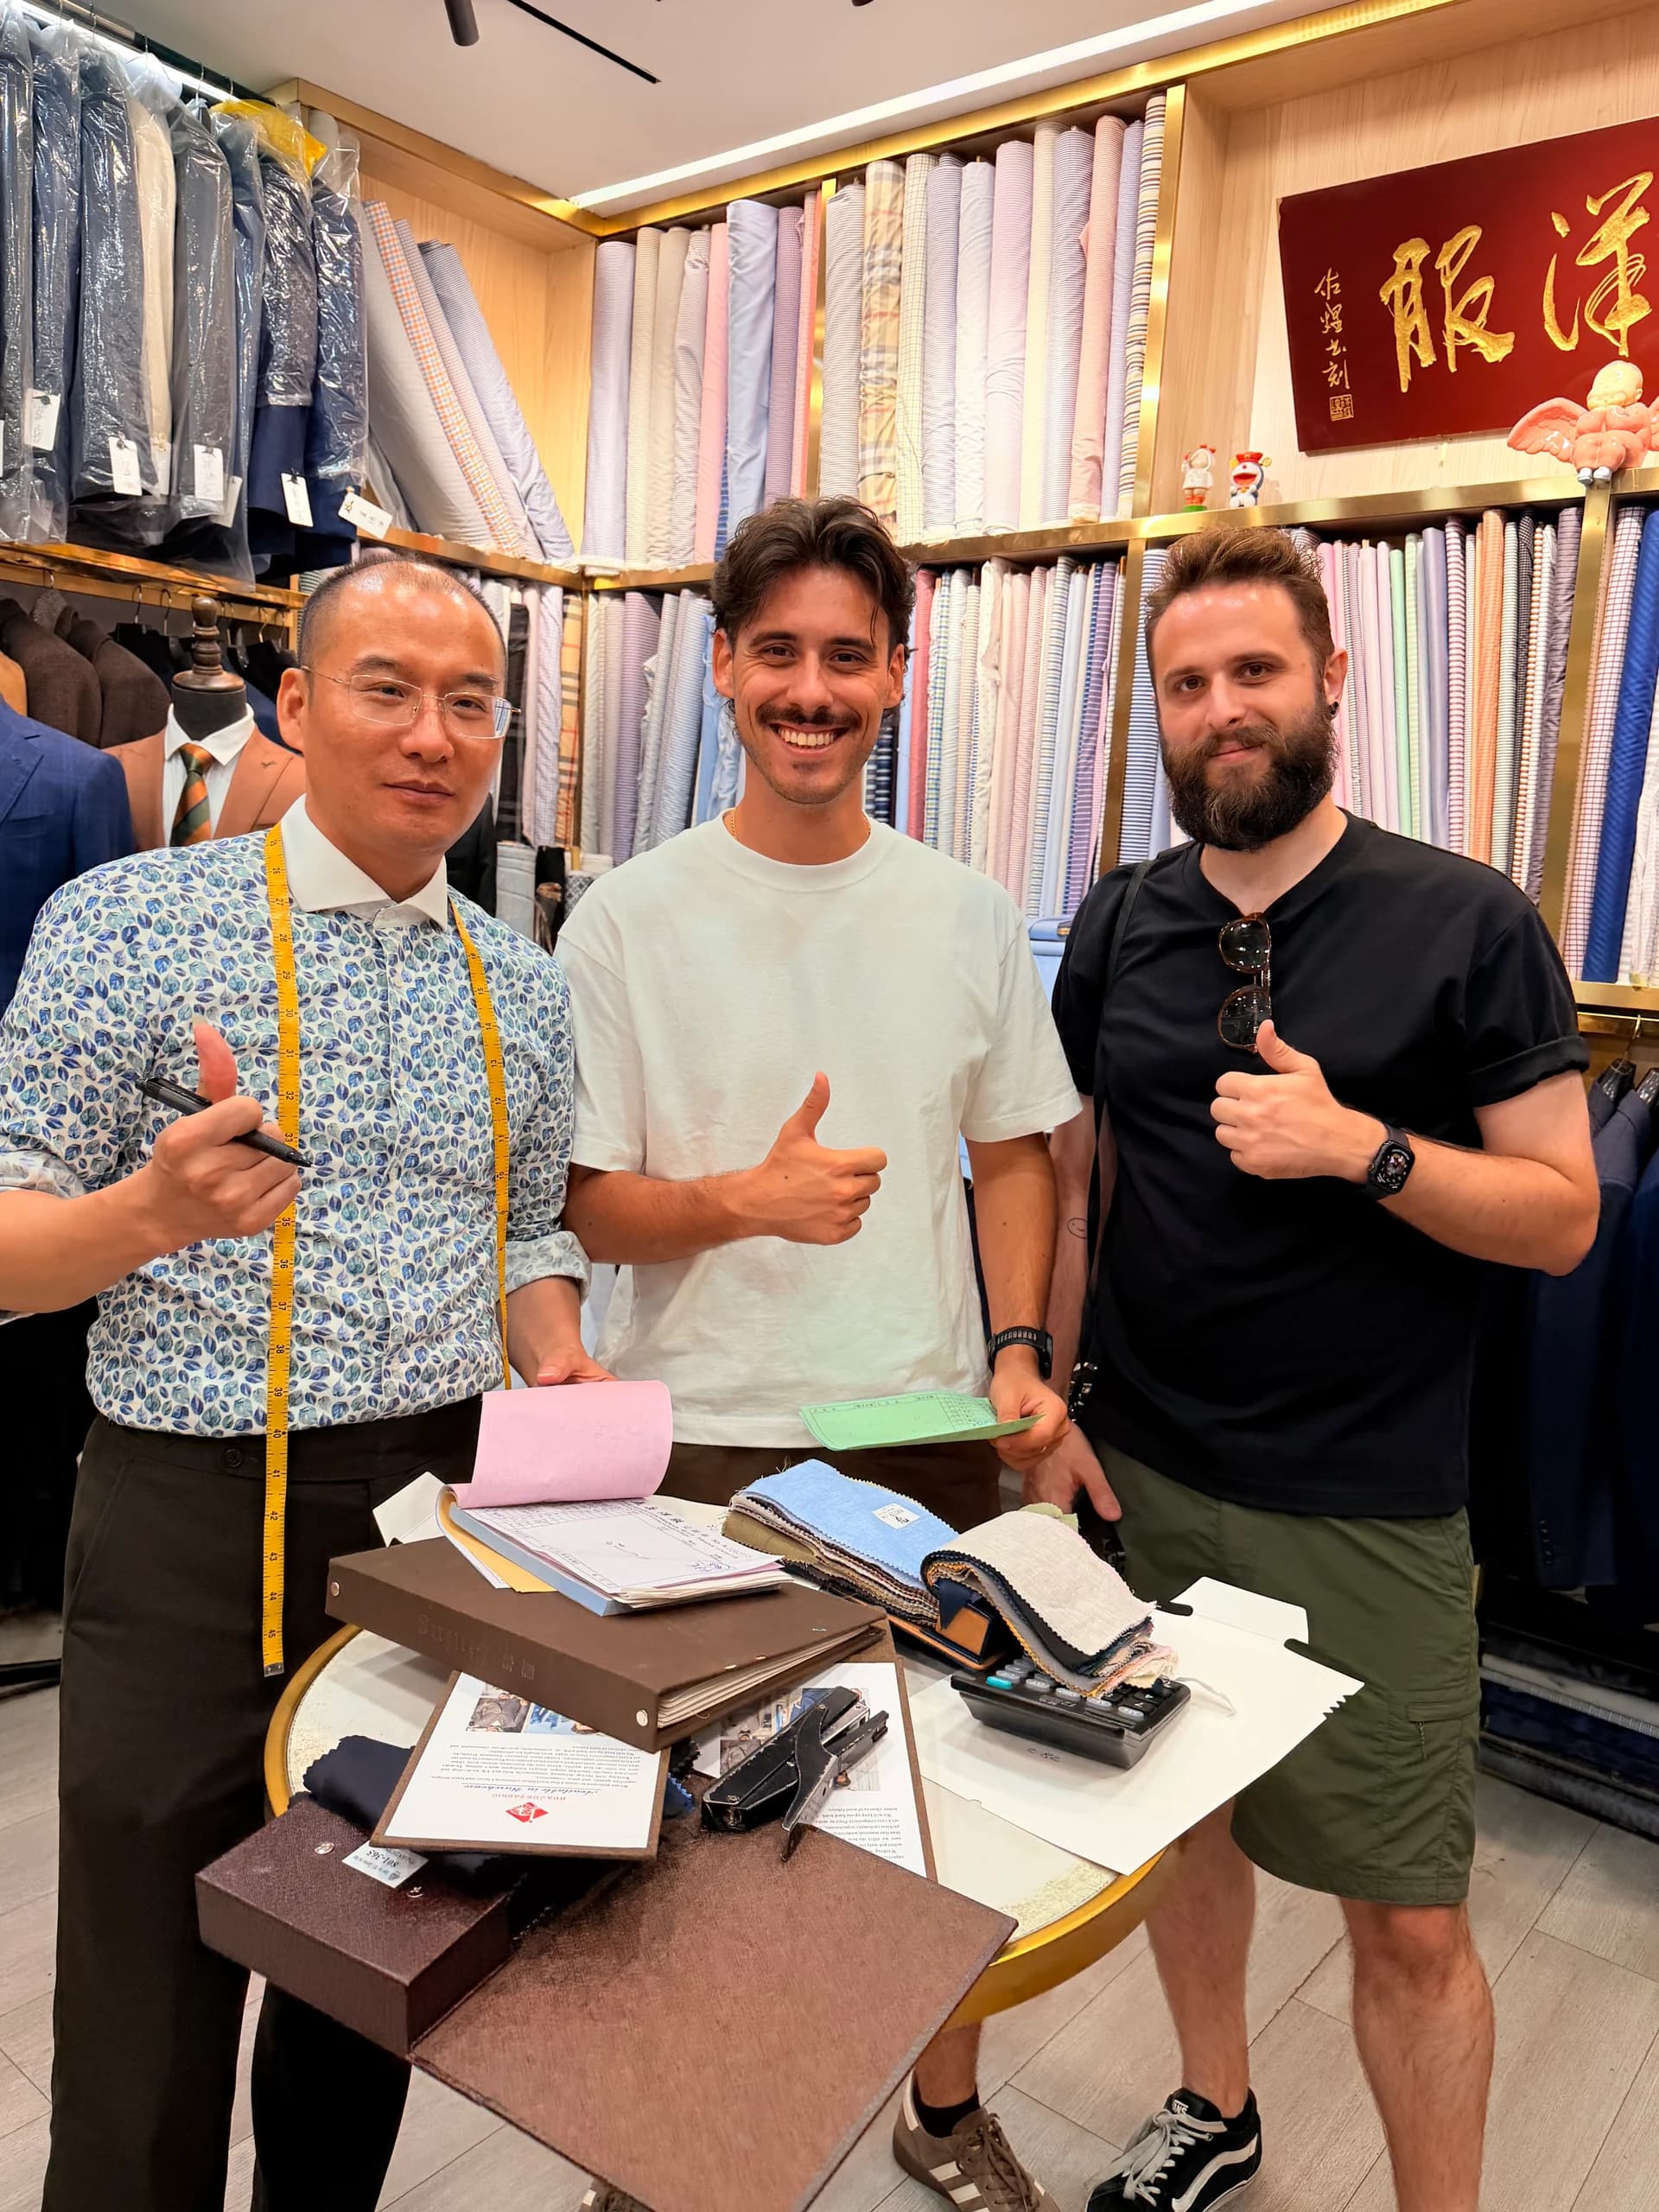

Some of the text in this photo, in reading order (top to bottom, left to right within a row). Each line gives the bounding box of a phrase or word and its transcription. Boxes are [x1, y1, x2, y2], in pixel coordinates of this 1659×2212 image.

[283, 971, 290, 980] 29
[286, 1091, 294, 1100] 32
[285, 1133, 293, 1142] 33
[283, 1217, 289, 1226] 35
[280, 1260, 288, 1268] 36
[278, 1302, 286, 1311] 37
[276, 1344, 284, 1353] 38
[274, 1388, 283, 1396] 39
[273, 1429, 282, 1439] 40
[270, 1511, 277, 1521] 42
[270, 1552, 277, 1560] 43
[269, 1592, 276, 1600] 44
[268, 1630, 276, 1638] 45
